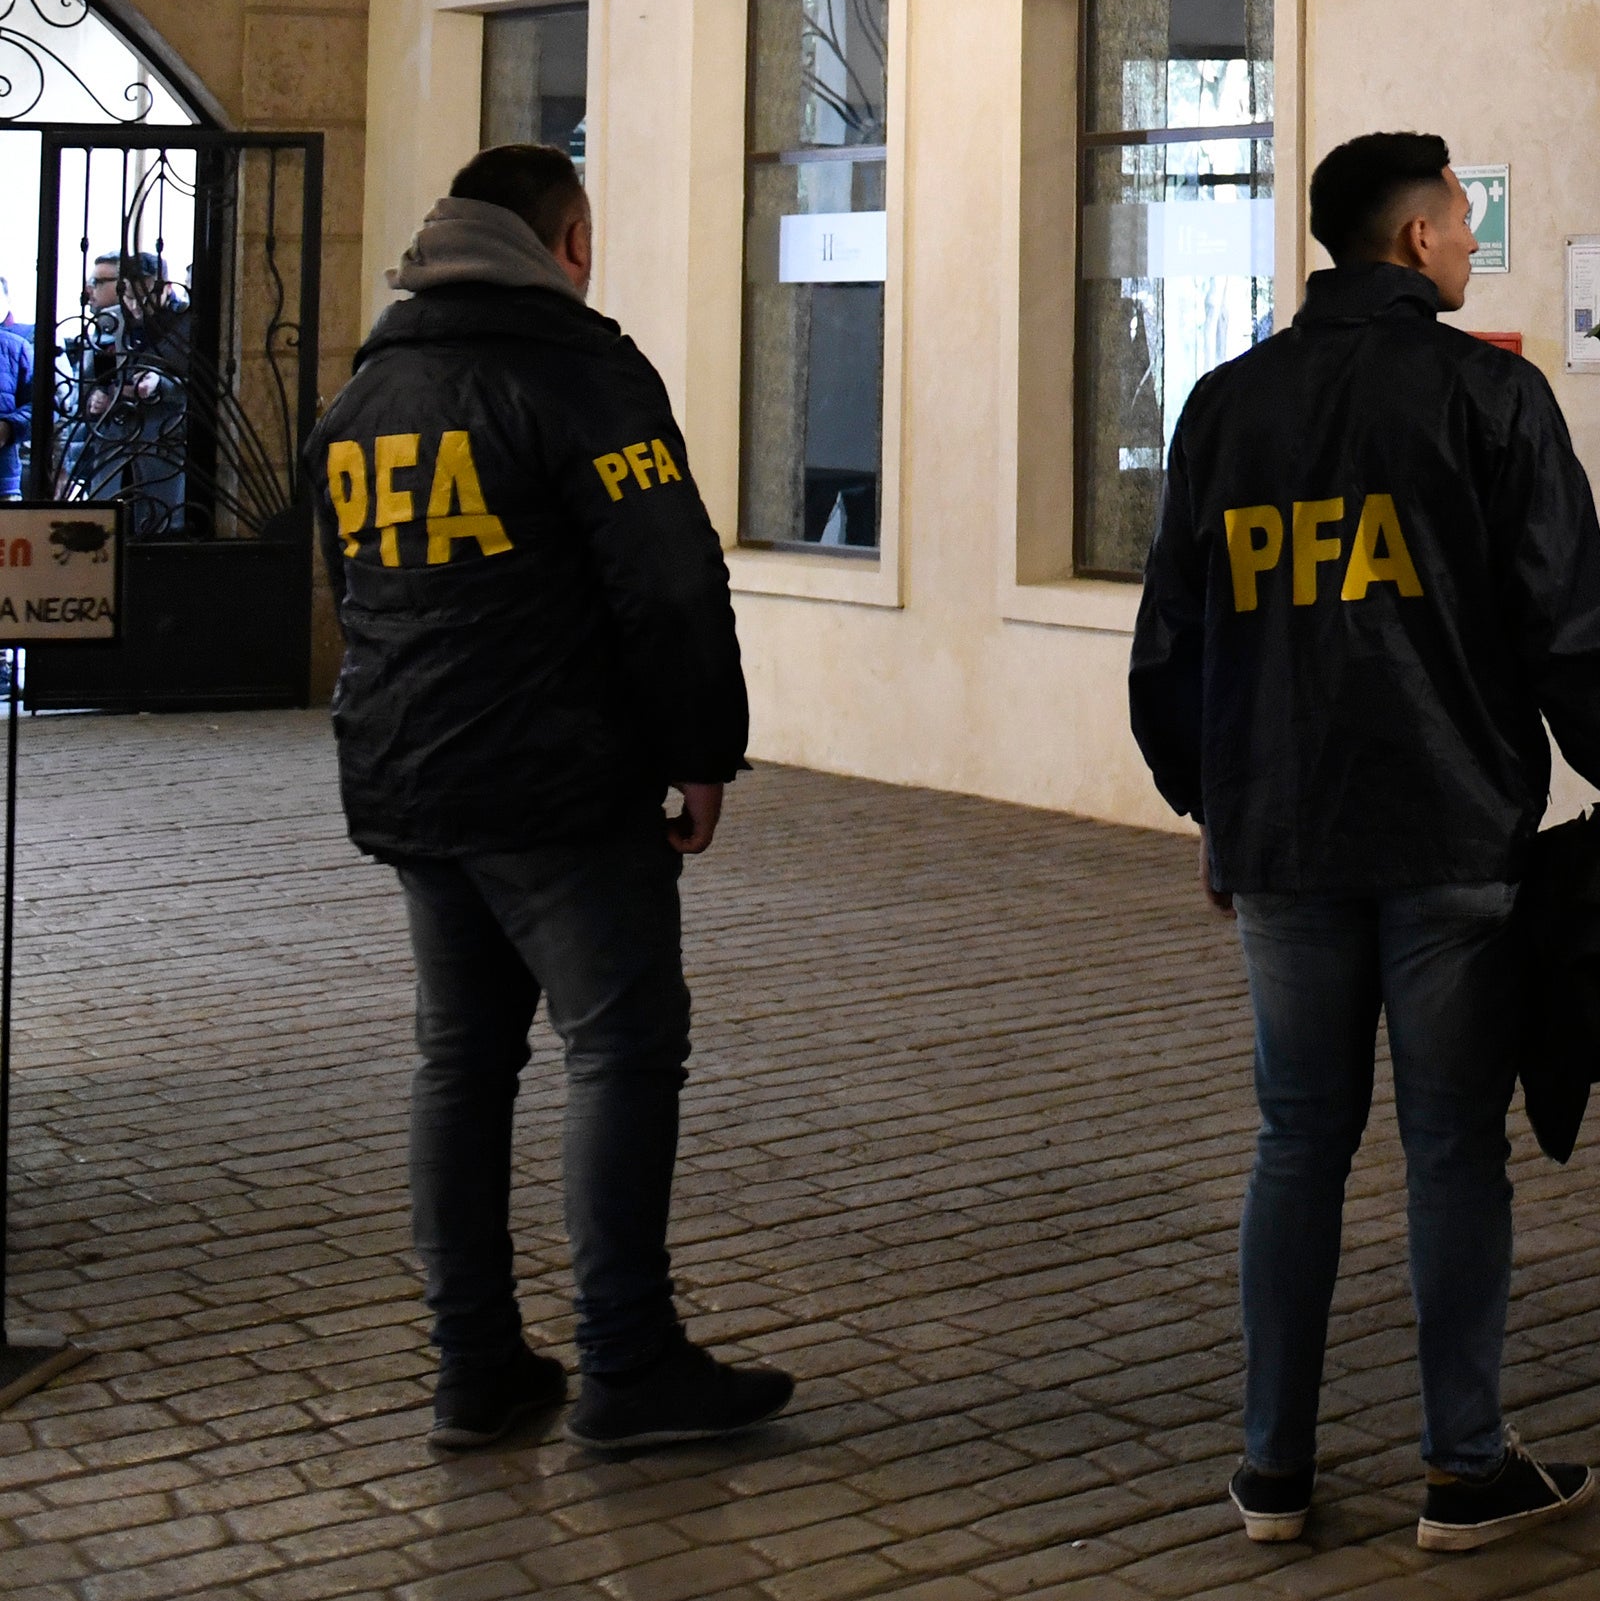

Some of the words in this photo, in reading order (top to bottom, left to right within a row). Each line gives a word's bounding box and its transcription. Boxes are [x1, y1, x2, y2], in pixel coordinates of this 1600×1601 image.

[327, 430, 514, 568] PFA
[593, 438, 682, 502] PFA
[1224, 493, 1425, 613] PFA
[25, 597, 115, 624] NEGRA
